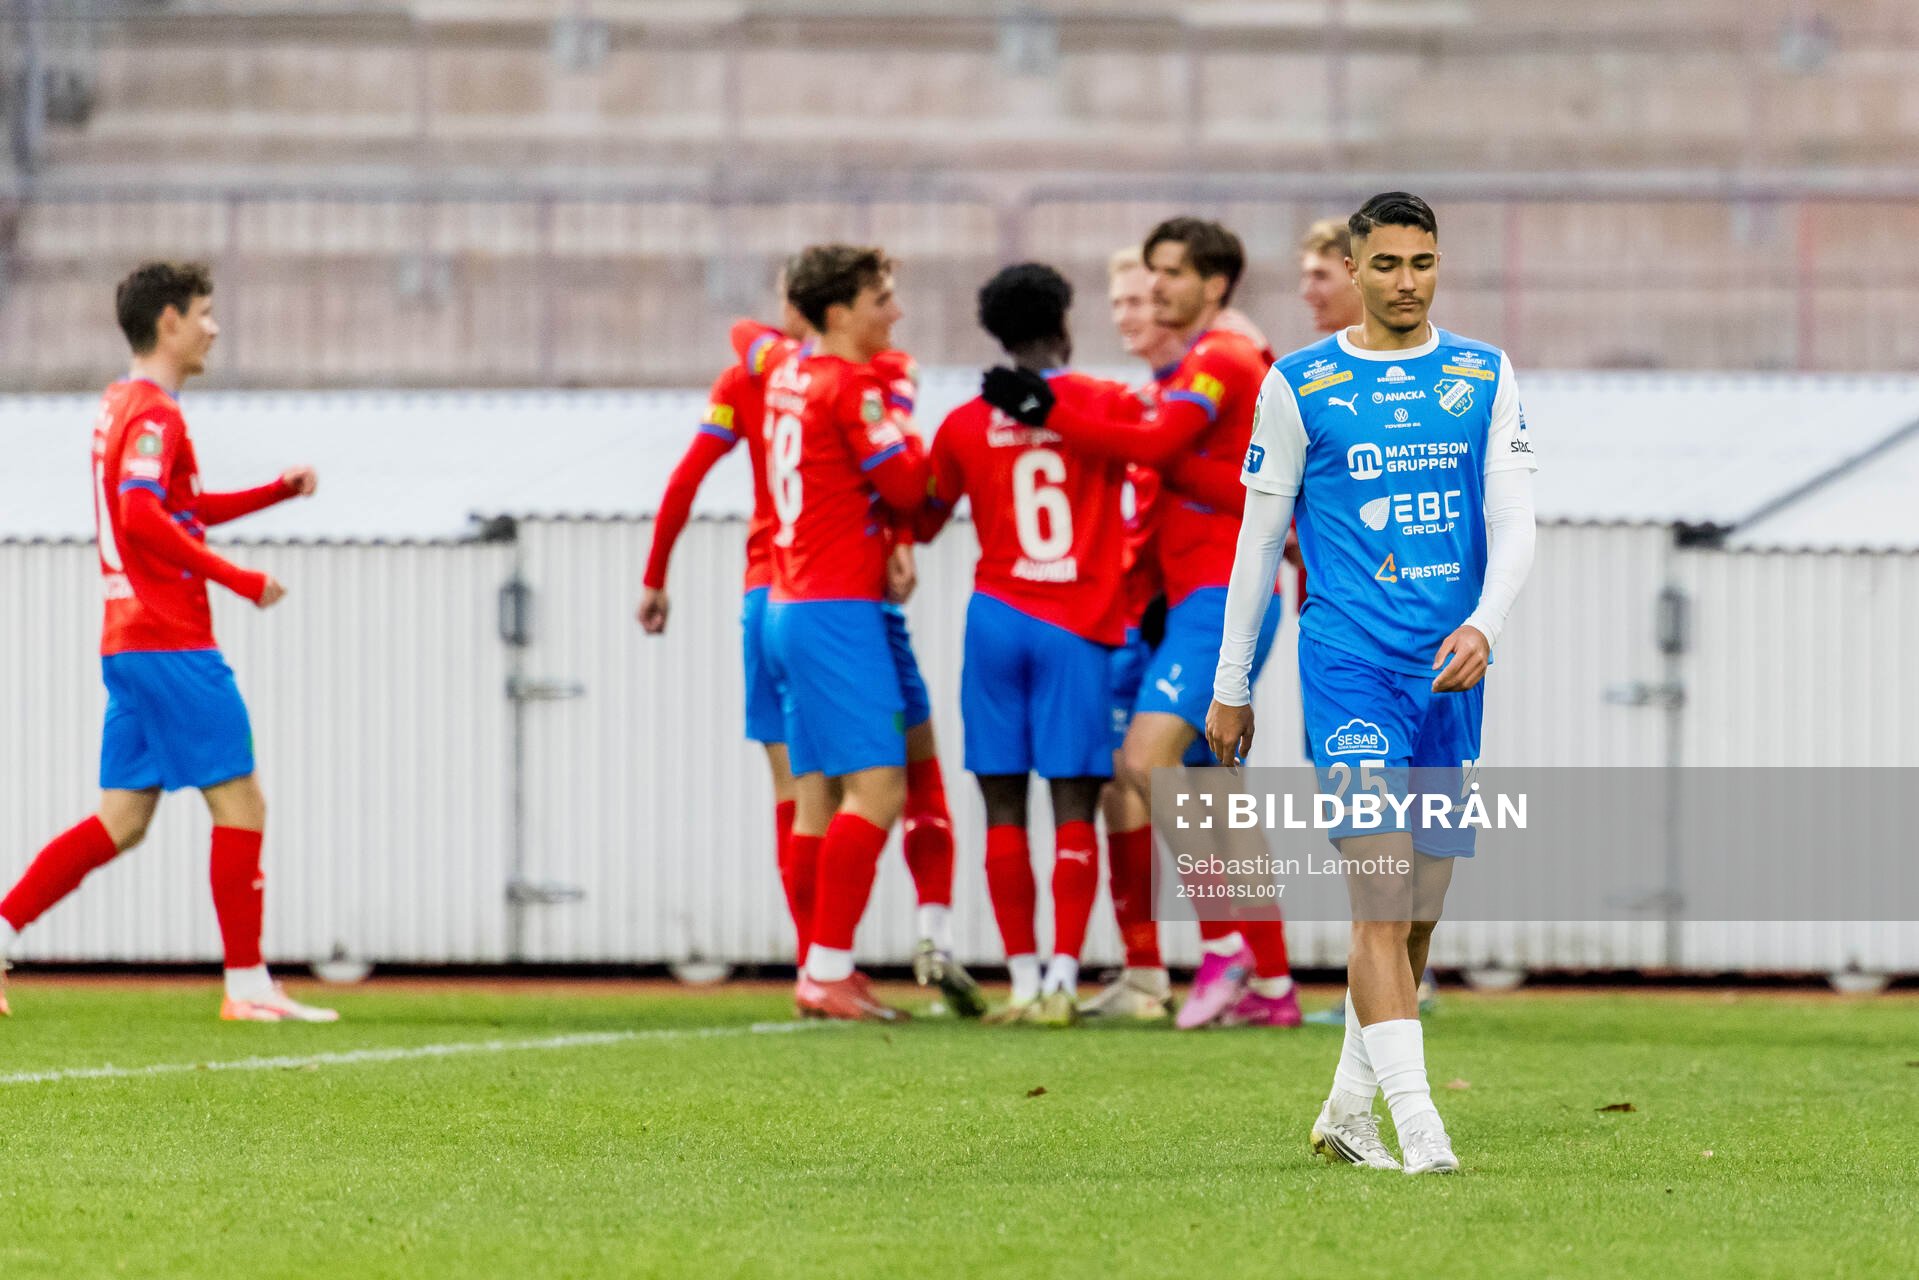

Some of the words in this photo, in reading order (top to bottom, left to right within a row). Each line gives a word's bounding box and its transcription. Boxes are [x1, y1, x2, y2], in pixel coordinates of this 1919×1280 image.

[1385, 390, 1426, 402] ANACKA
[1385, 442, 1468, 458] MATTSSON
[1386, 457, 1458, 473] GRUPPEN
[1013, 448, 1073, 561] 6
[1393, 490, 1461, 523] EBC
[1402, 522, 1455, 535] GROUP
[1401, 562, 1460, 580] FYRSTADS
[1337, 734, 1378, 746] SESAB
[1327, 759, 1389, 817] 25
